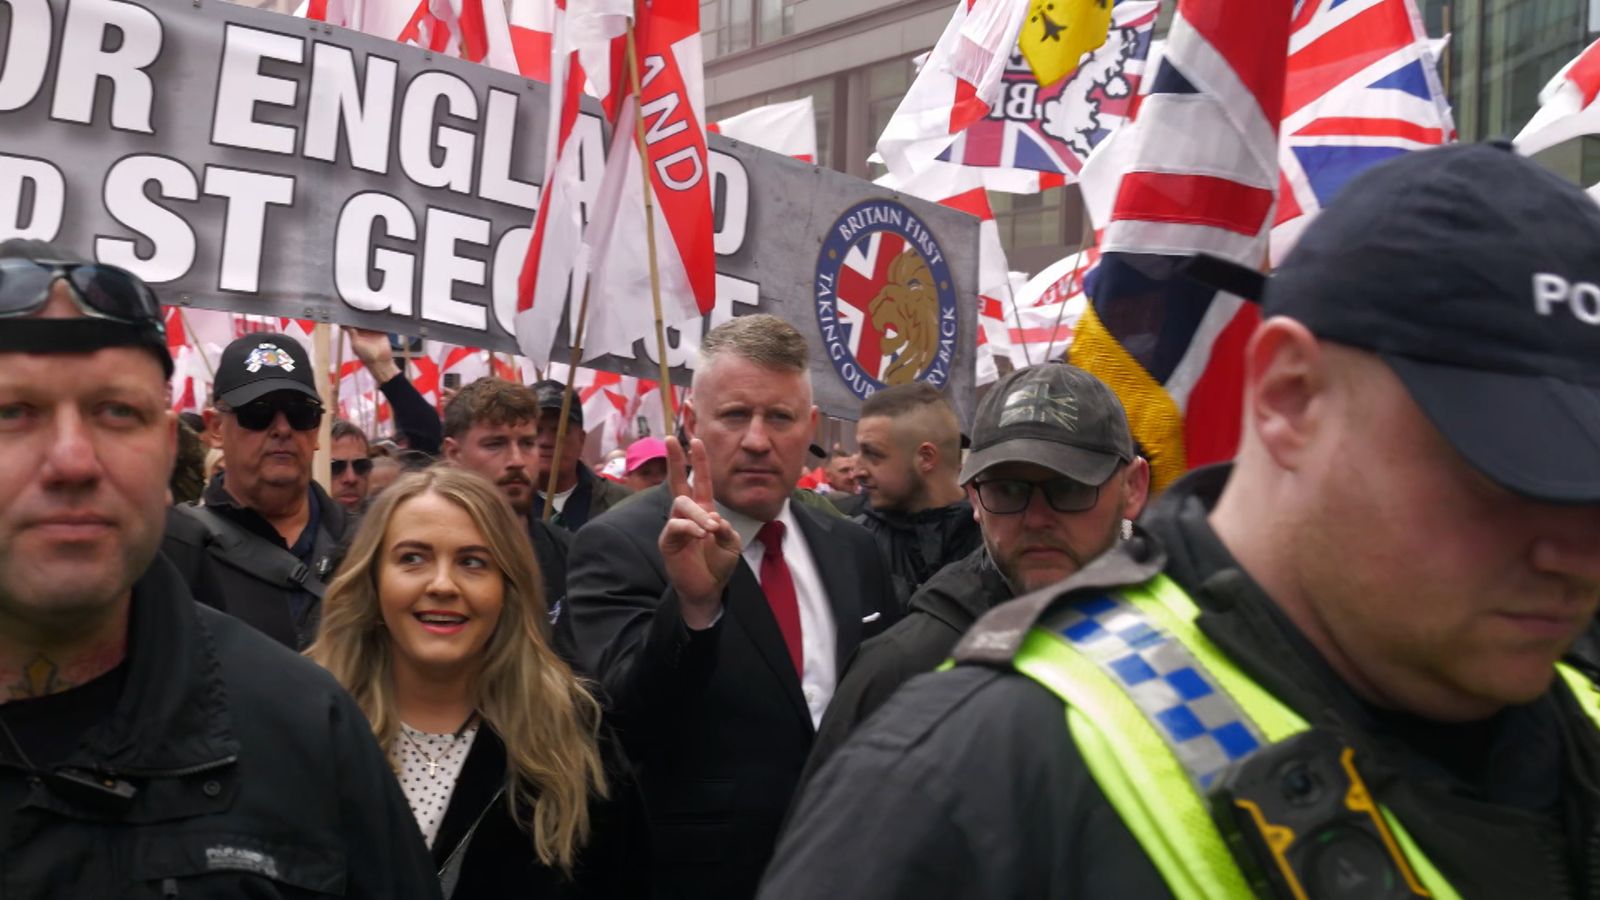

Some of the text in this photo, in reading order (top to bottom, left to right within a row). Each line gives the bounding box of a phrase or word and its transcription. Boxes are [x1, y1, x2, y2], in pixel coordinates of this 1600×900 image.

[211, 23, 748, 256] ENGLAD
[95, 154, 295, 292] ST
[839, 206, 943, 265] BRITAIN FIRST
[818, 273, 846, 360] TAKING
[939, 306, 956, 363] BACK
[1532, 272, 1600, 325] PO
